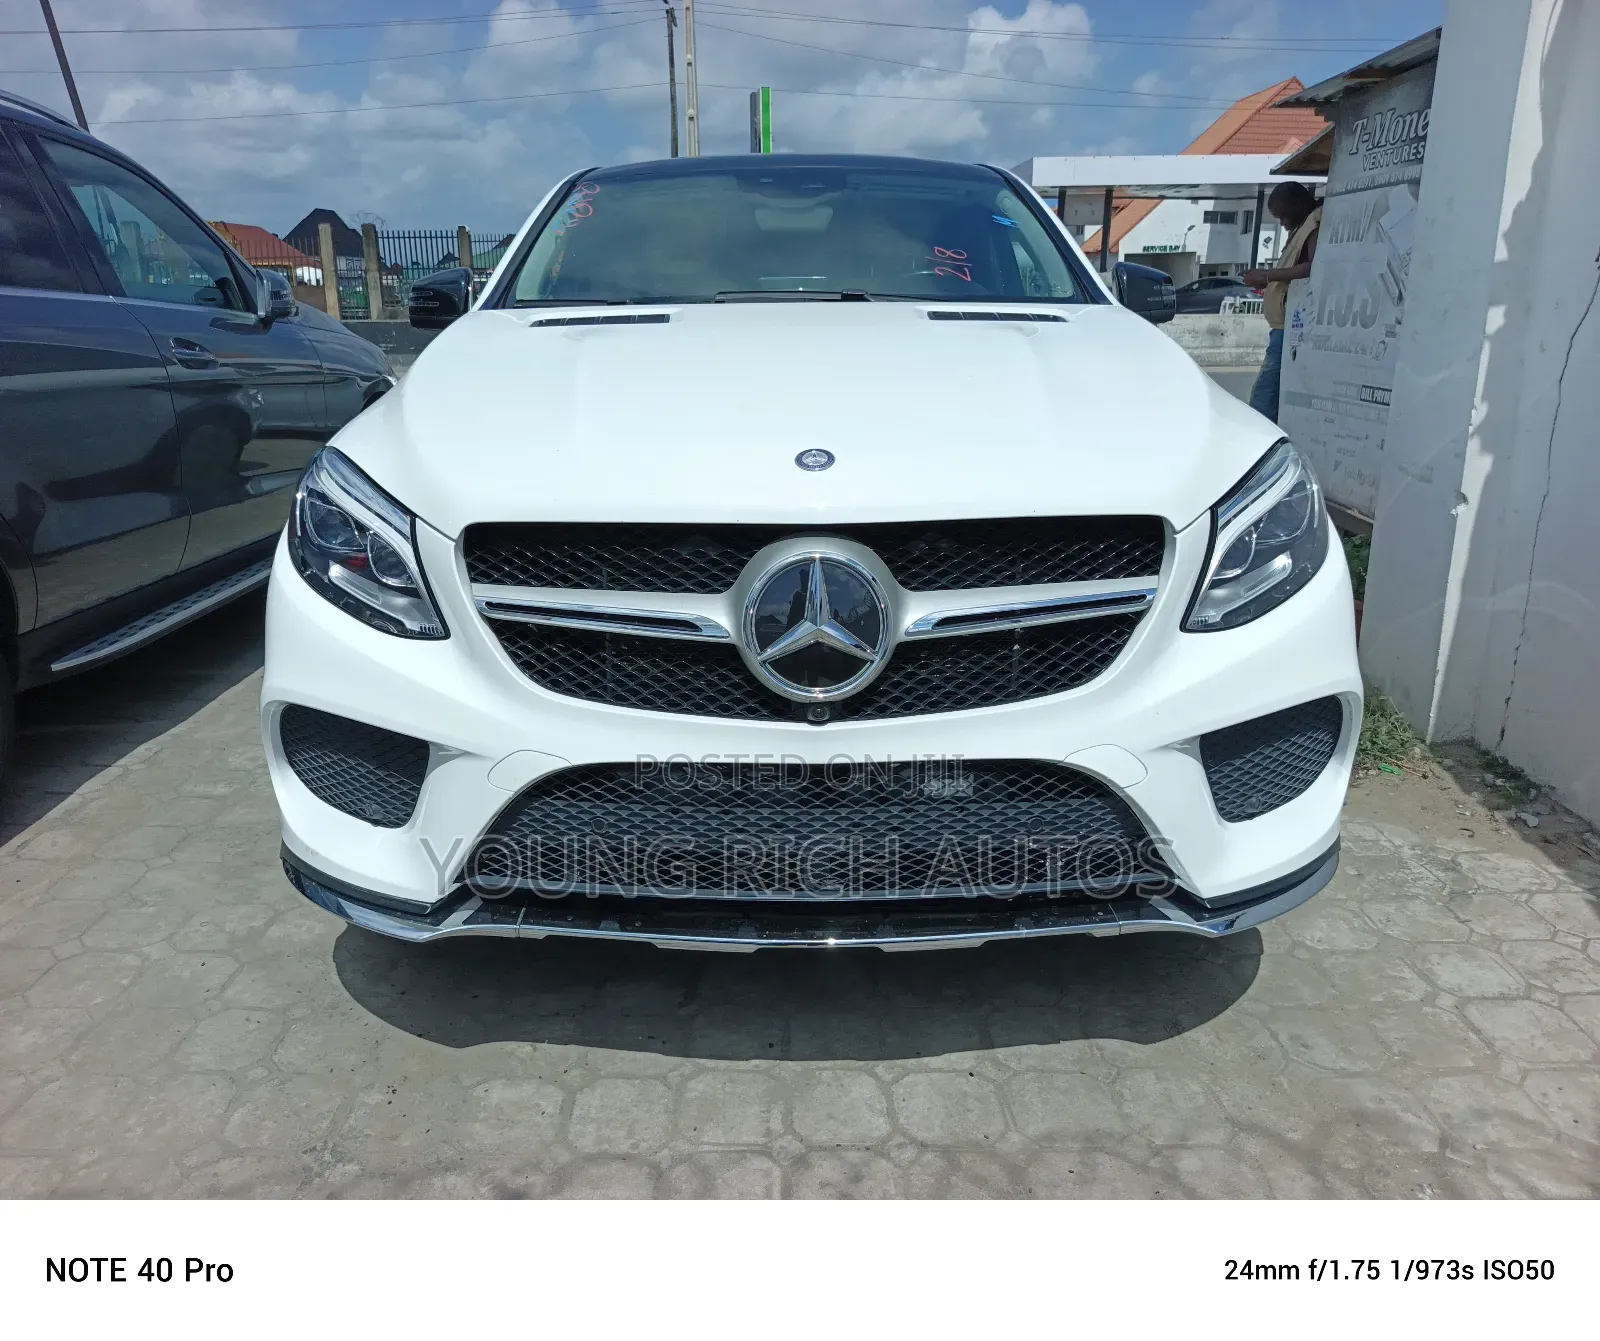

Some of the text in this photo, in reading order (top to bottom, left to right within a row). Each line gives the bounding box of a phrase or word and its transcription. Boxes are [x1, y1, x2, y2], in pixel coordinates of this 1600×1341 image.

[1362, 142, 1426, 172] VENTURES
[1142, 244, 1181, 253] SERVICE BAY
[1361, 386, 1373, 402] BILL
